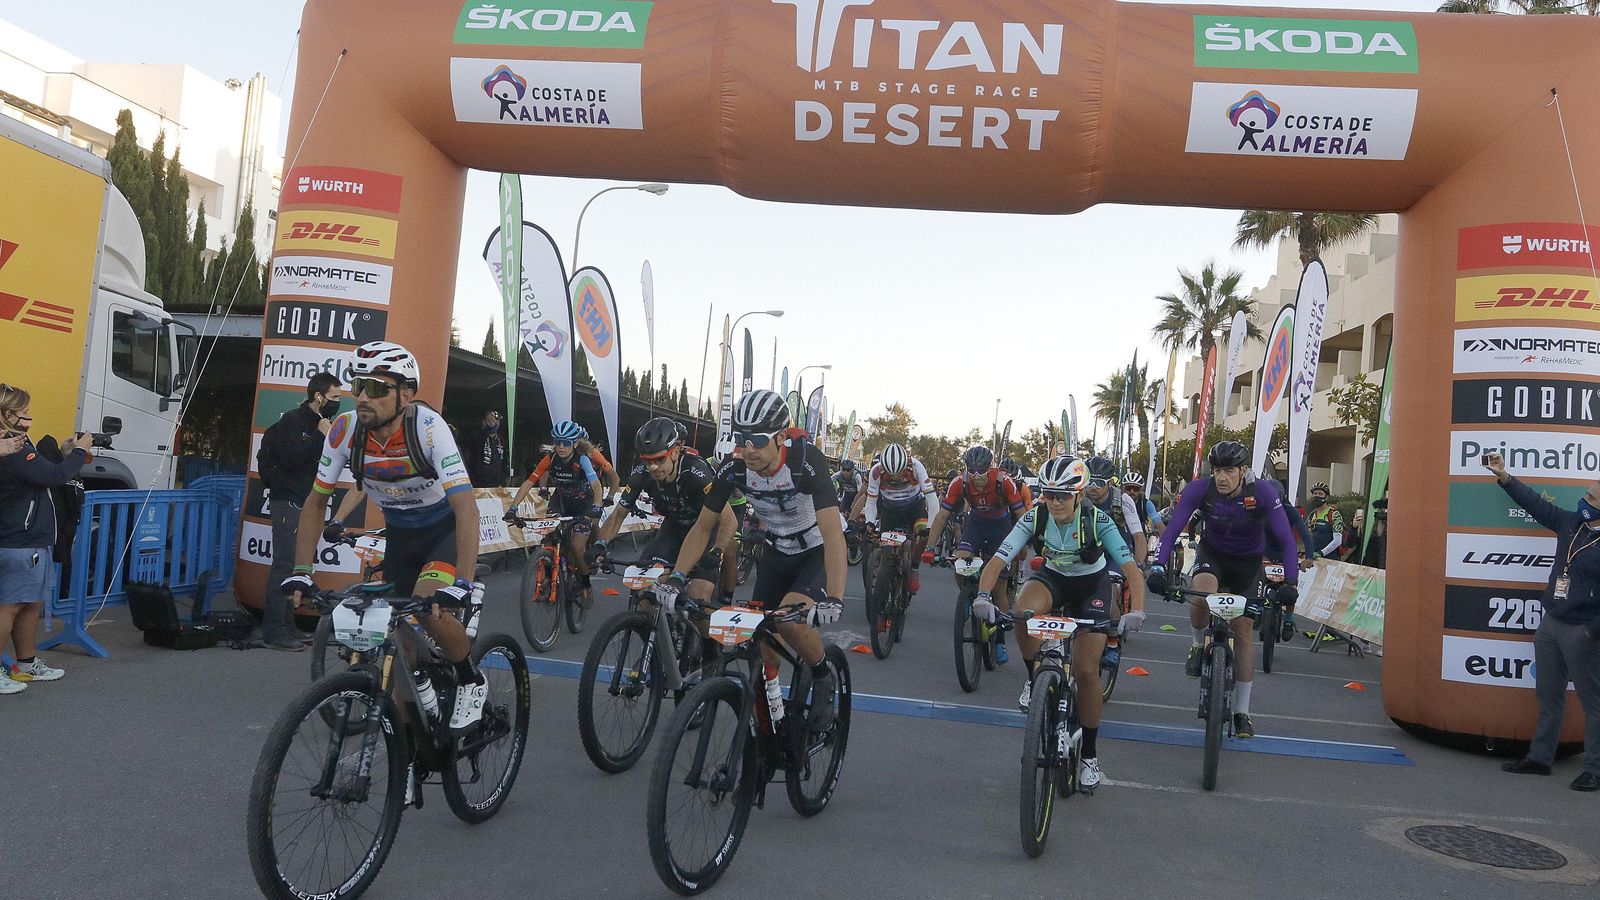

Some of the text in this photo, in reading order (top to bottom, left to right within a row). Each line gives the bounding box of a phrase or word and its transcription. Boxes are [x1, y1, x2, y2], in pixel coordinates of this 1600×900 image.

[465, 4, 636, 33] ŠKODA
[771, 0, 1064, 75] TITAN
[1205, 23, 1407, 56] ŠKODA
[532, 87, 607, 102] COSTA DE
[814, 79, 1038, 98] MTB STAGE RACE
[519, 103, 610, 125] ALMERÍA
[1284, 115, 1373, 131] COSTA DE
[795, 100, 1060, 151] DESERT
[1260, 133, 1368, 155] ALMERÍA
[312, 179, 364, 194] WÜRTH
[289, 222, 366, 244] DHL
[1526, 238, 1590, 253] WÜRTH
[289, 265, 378, 284] NORMATEC
[1493, 288, 1596, 310] DHL
[276, 306, 358, 340] GOBIK
[263, 353, 354, 384] Primaflo
[1487, 386, 1593, 421] GOBIK
[1461, 440, 1600, 471] Primaflo
[479, 525, 502, 541] LMERÍA
[1462, 551, 1555, 568] LAPIE
[638, 568, 649, 576] 2
[1217, 596, 1235, 605] 20
[1354, 589, 1385, 618] ŠKOD
[730, 613, 742, 624] 4
[1488, 597, 1546, 630] 226
[1037, 620, 1066, 630] 201
[1465, 655, 1536, 680] eur
